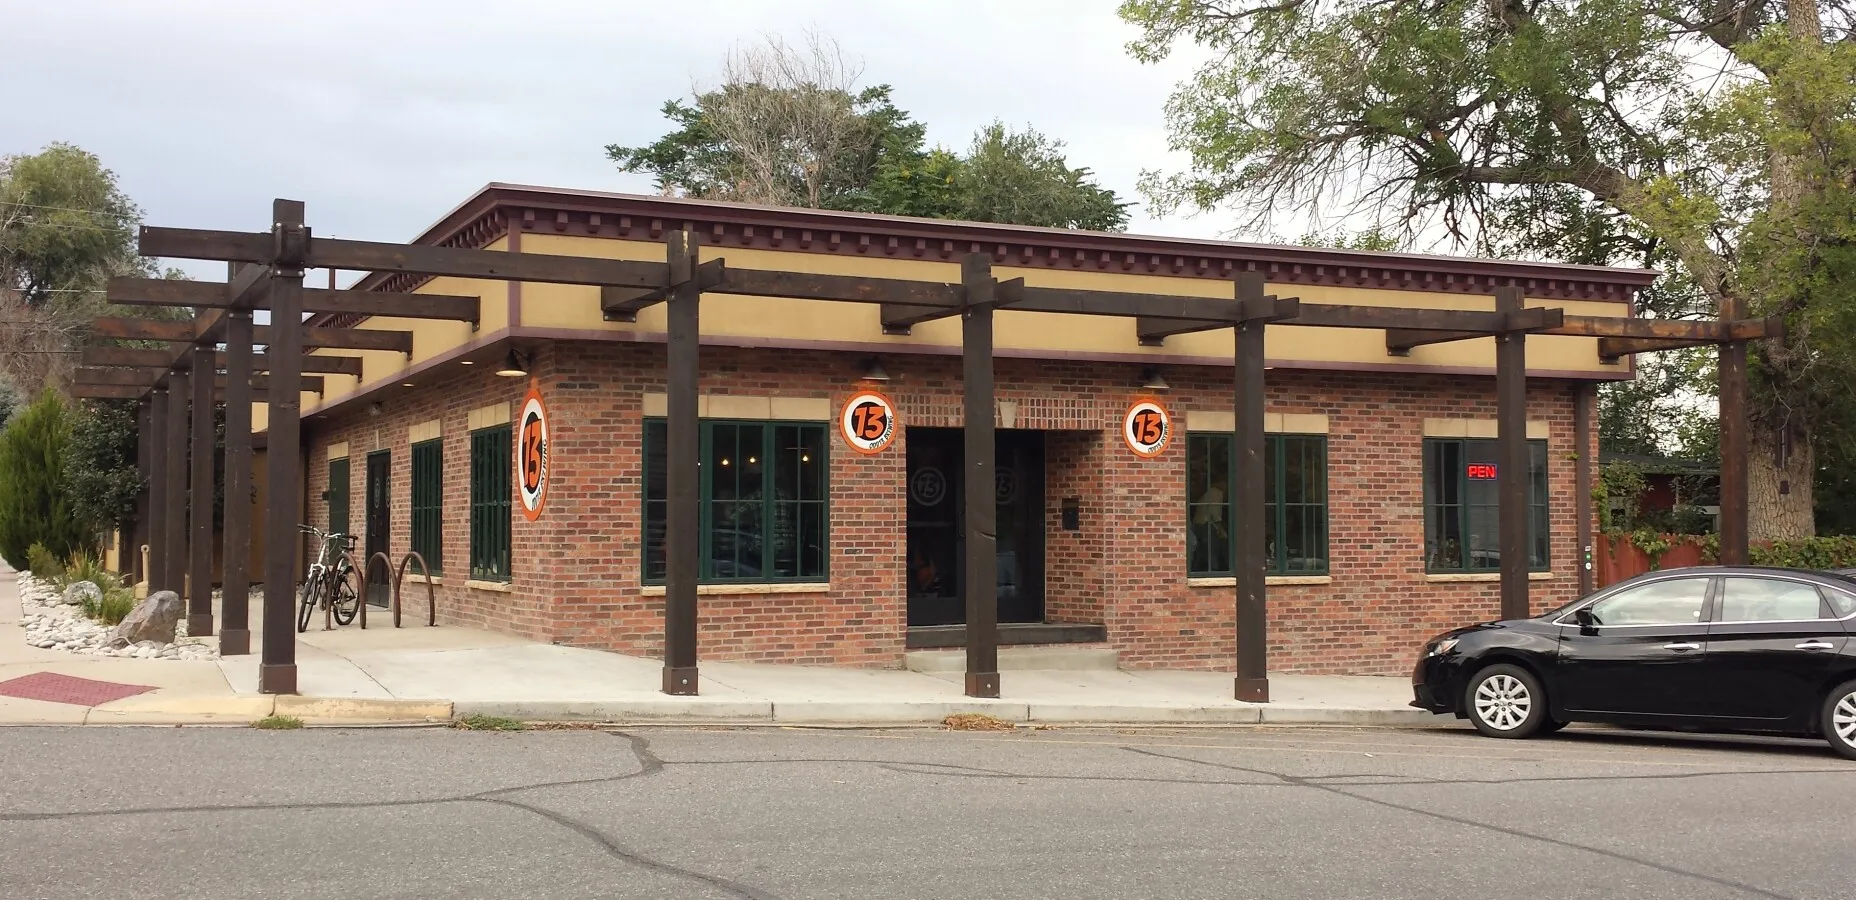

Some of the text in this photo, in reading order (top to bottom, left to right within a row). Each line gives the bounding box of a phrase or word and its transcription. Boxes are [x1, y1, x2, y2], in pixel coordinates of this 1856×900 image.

[855, 406, 885, 438] 13
[1135, 413, 1161, 443] 13
[523, 419, 542, 488] 13
[919, 474, 939, 495] 13
[1468, 465, 1495, 478] PEN
